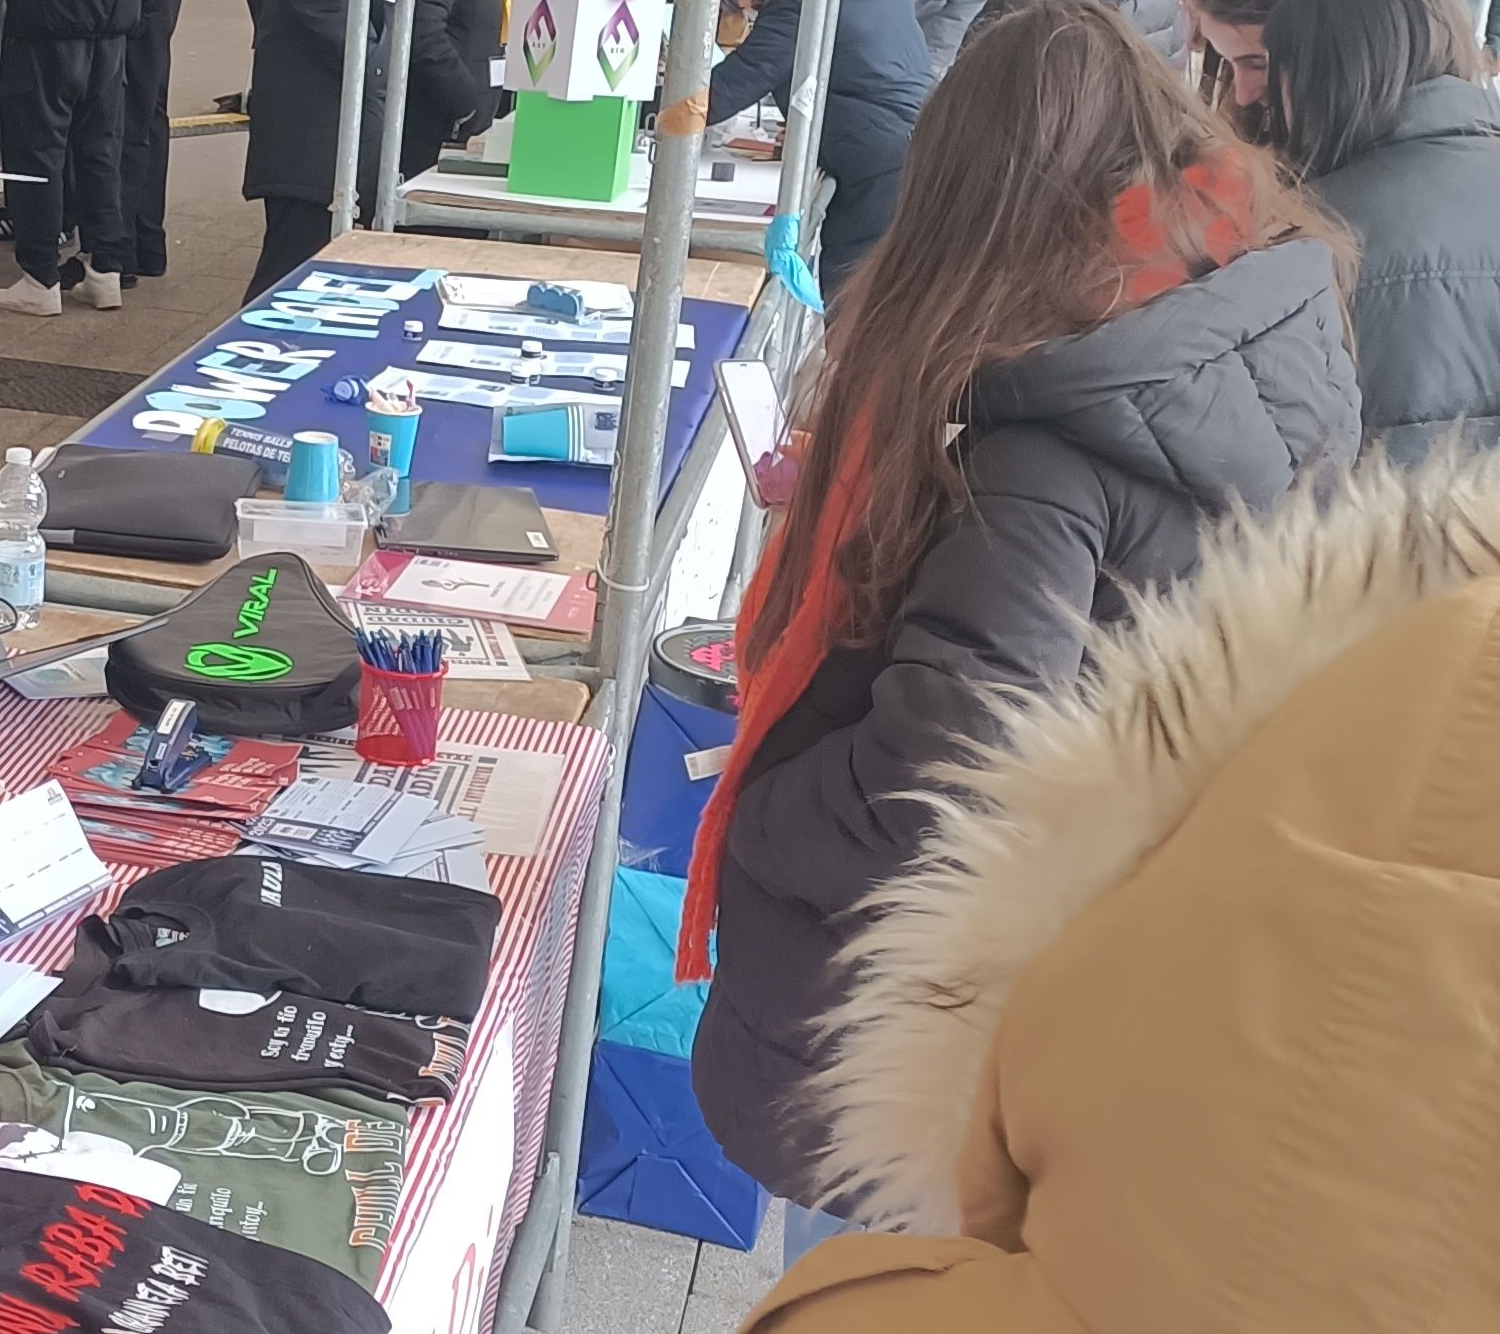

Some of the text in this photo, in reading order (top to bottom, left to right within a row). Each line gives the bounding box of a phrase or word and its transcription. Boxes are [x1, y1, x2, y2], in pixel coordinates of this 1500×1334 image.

[132, 269, 449, 436] POWER PADEL
[222, 437, 263, 457] PELOTAS
[263, 445, 277, 460] DE
[229, 427, 293, 448] TENNIS BALLS
[232, 566, 279, 640] VIRAL
[150, 1245, 210, 1287] BETI
